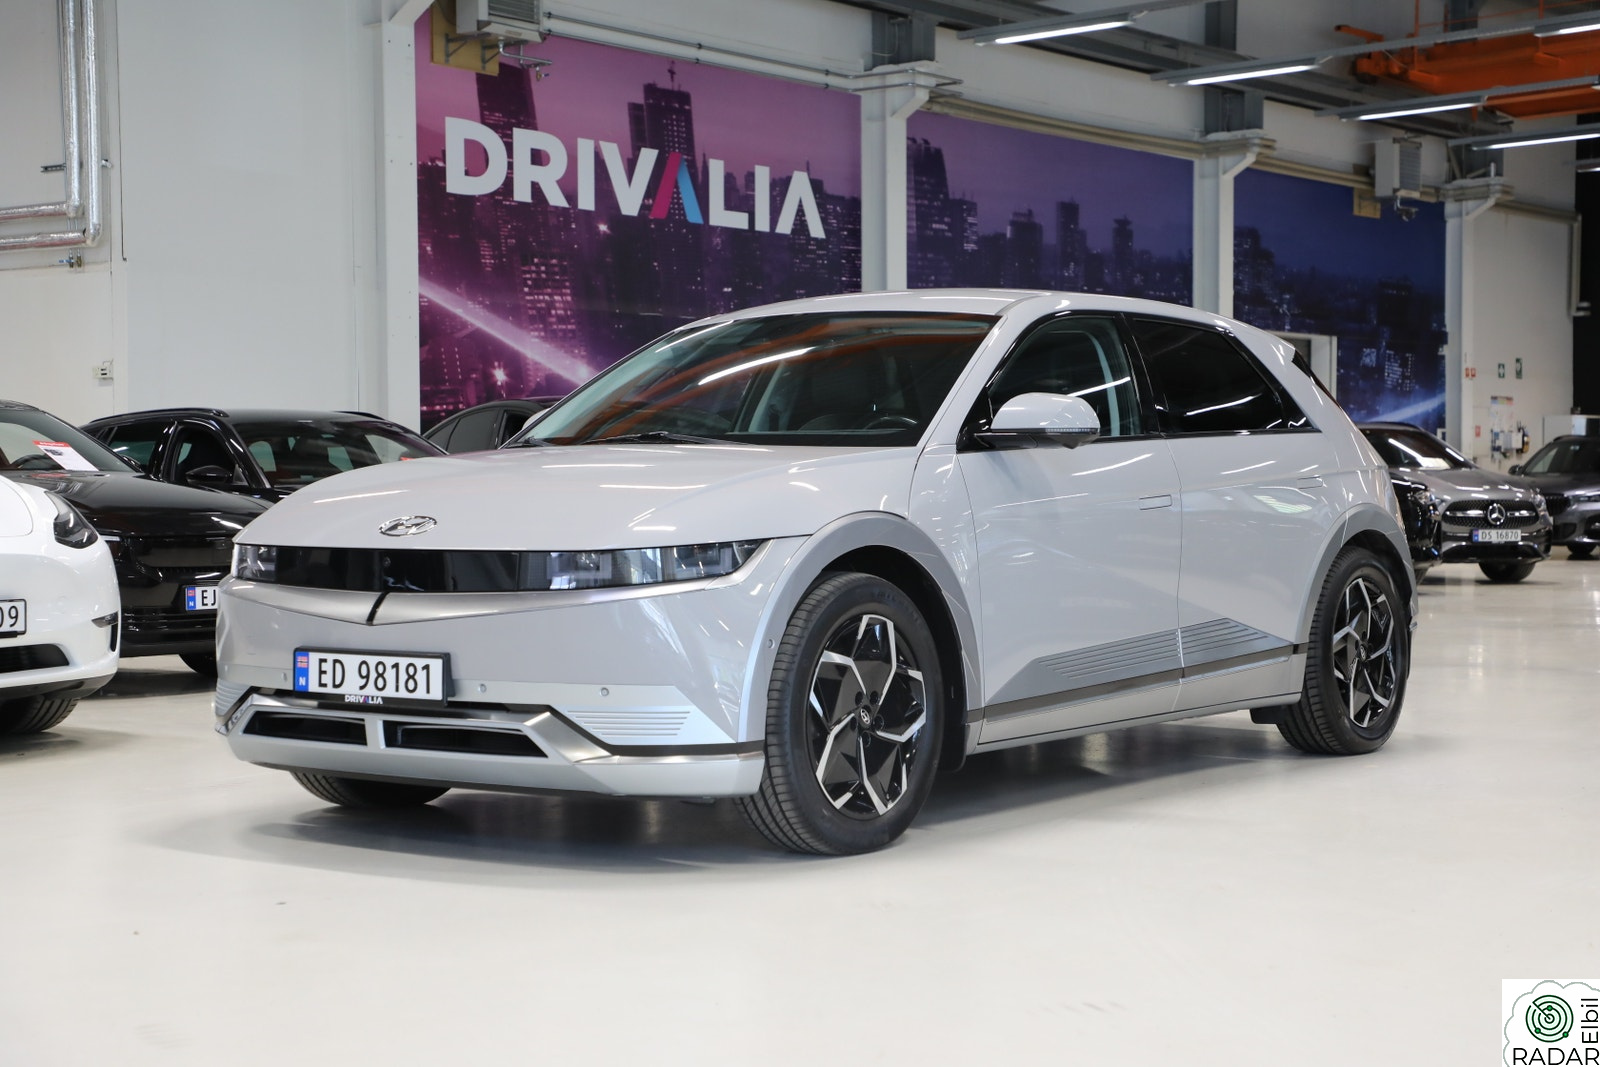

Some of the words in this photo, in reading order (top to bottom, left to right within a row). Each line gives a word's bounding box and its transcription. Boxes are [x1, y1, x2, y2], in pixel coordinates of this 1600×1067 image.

[445, 116, 826, 239] DRIVALIA
[201, 589, 216, 606] EJ
[299, 677, 306, 686] N
[318, 658, 346, 689] ED
[358, 660, 430, 694] 98181
[344, 694, 384, 705] DRIVALIA
